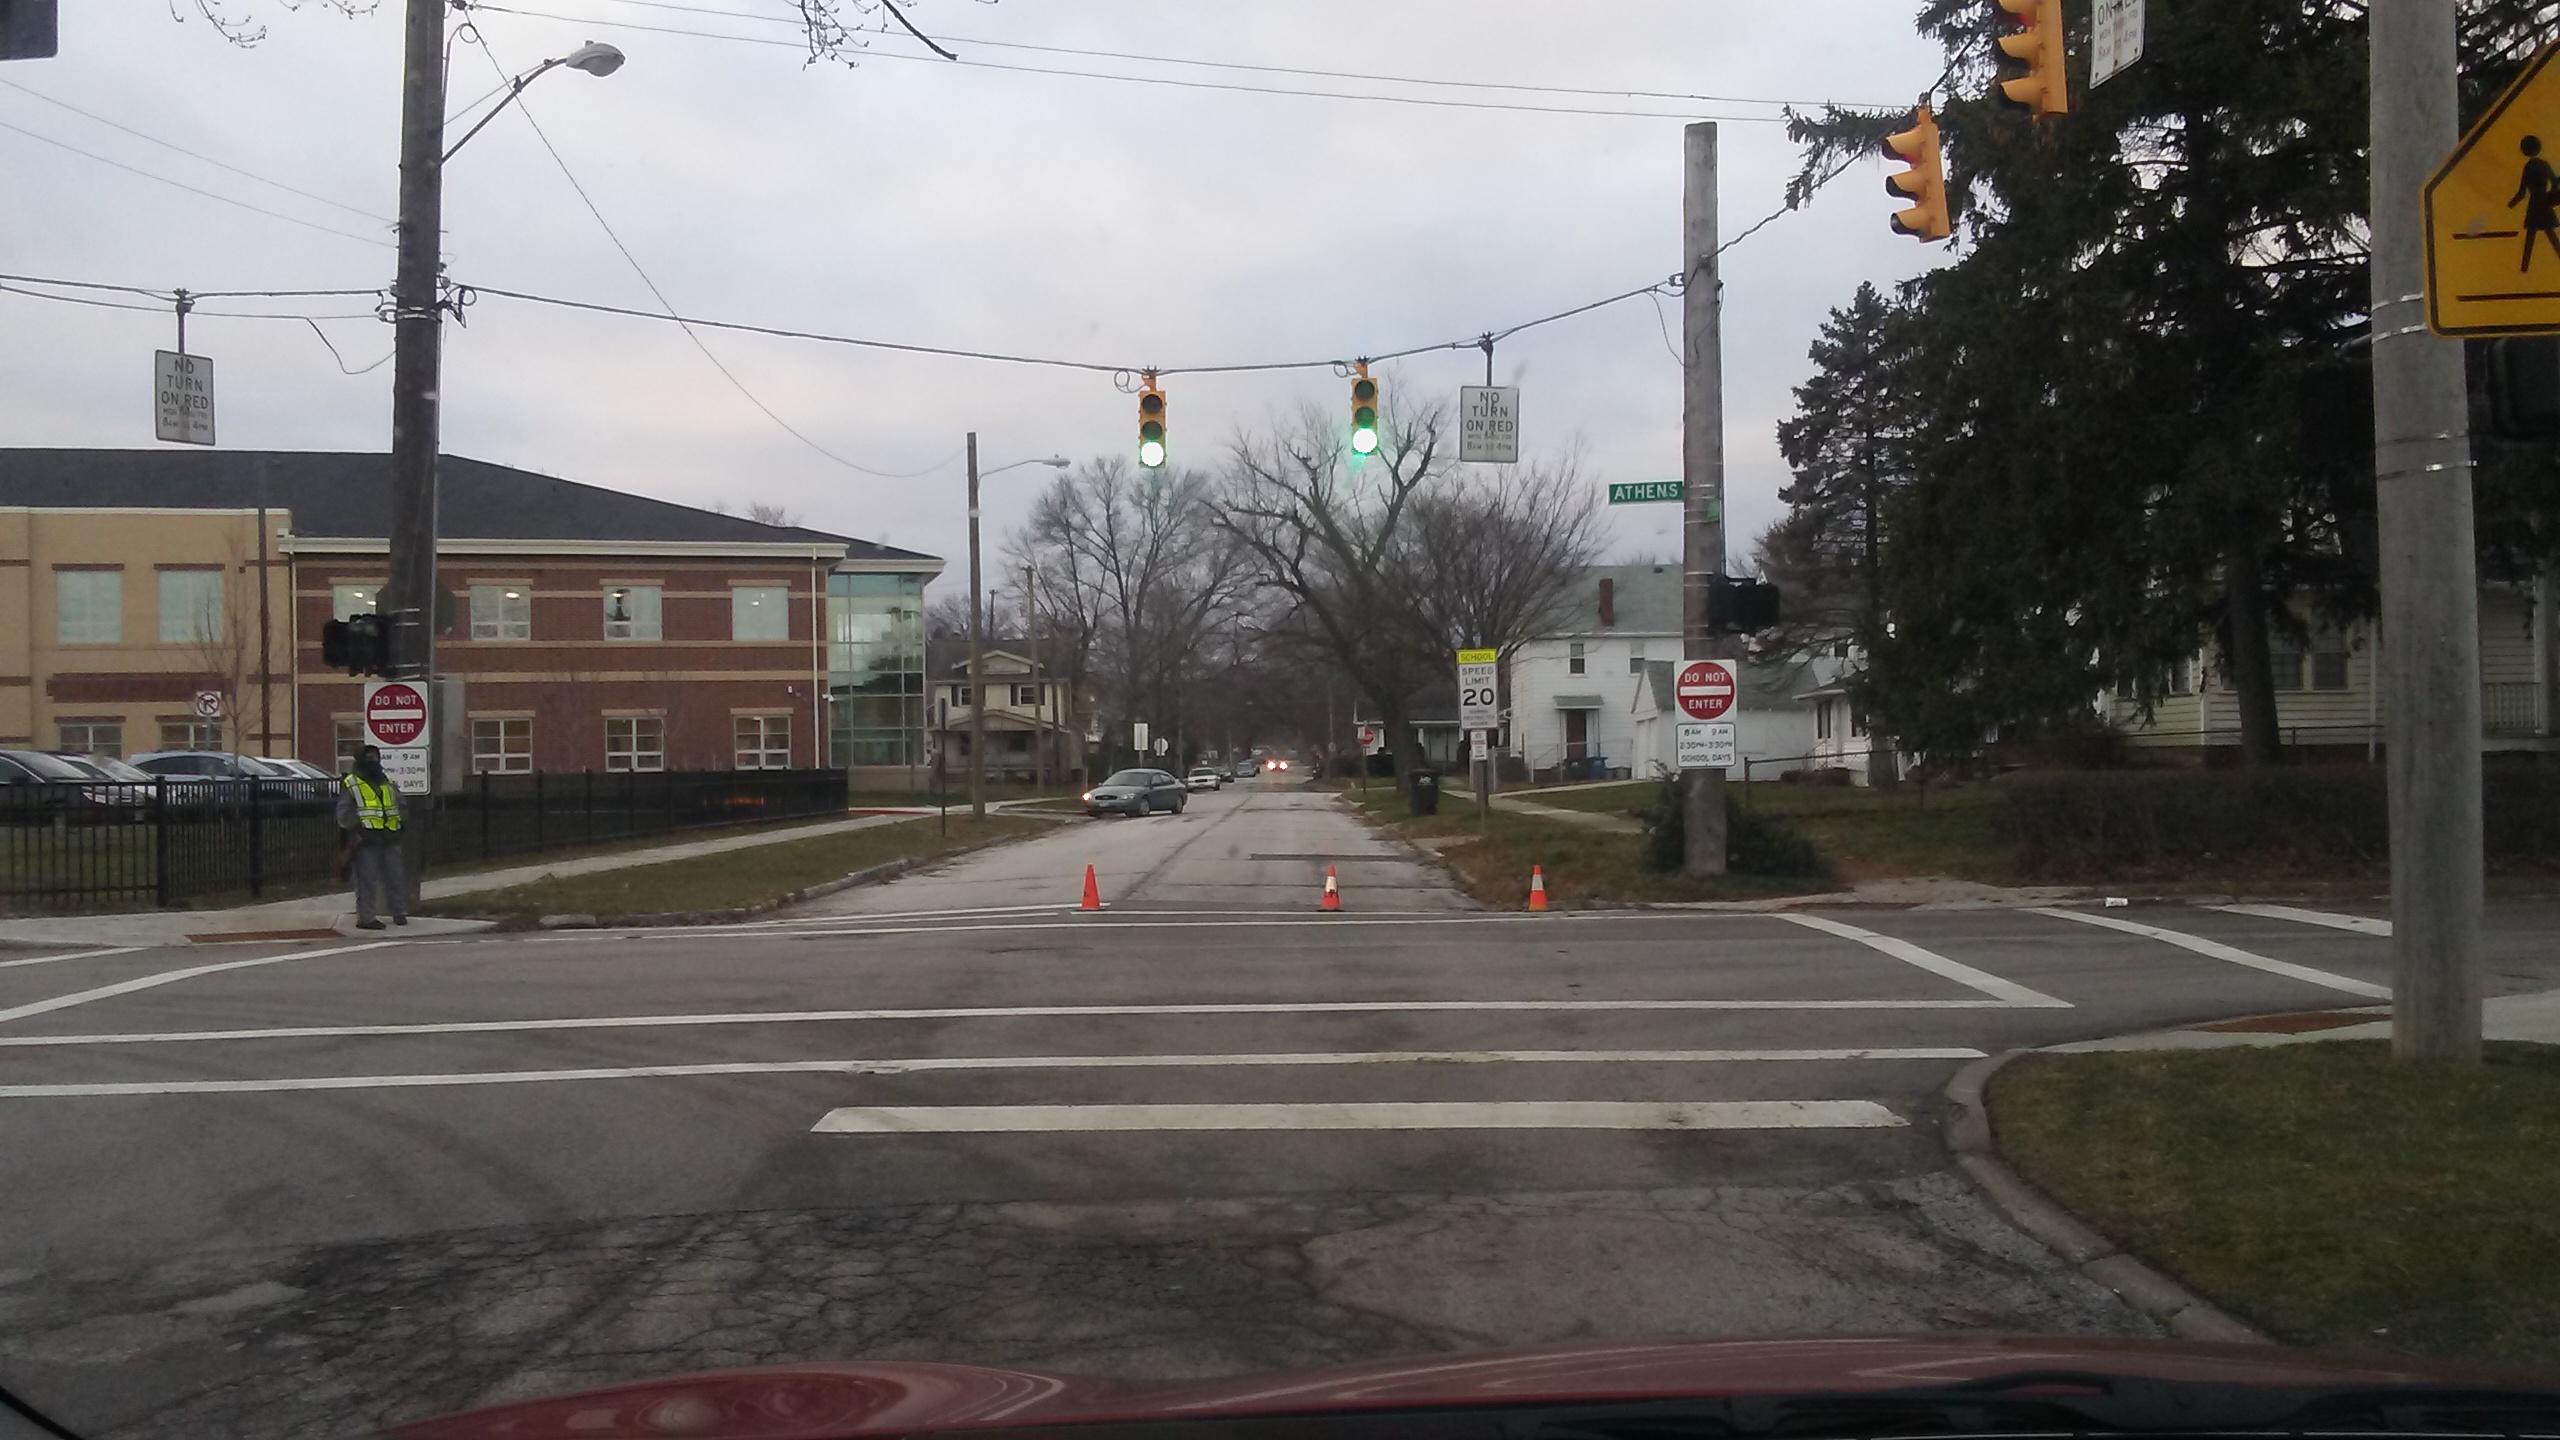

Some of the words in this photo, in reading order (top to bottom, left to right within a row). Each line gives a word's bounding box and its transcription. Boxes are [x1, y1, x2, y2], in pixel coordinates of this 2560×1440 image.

[2097, 2, 2113, 26] ON
[175, 357, 195, 374] NO
[167, 375, 203, 392] TURN
[161, 391, 179, 405] ON
[184, 394, 208, 409] RED
[1480, 392, 1500, 404] NO
[1472, 405, 1508, 418] TURN
[1466, 420, 1484, 432] ON
[1489, 420, 1514, 432] RED
[1614, 483, 1679, 500] ATHENS
[1460, 653, 1493, 661] SCHOOL
[1461, 666, 1494, 675] SPEED
[1466, 677, 1490, 686] LIMIT
[1684, 673, 1699, 683] DO
[1705, 672, 1726, 683] NOT
[375, 696, 390, 706] DO
[396, 695, 417, 706] NOT
[1463, 688, 1494, 706] 20
[1688, 699, 1723, 710] ENTER
[379, 724, 415, 734] ENTER
